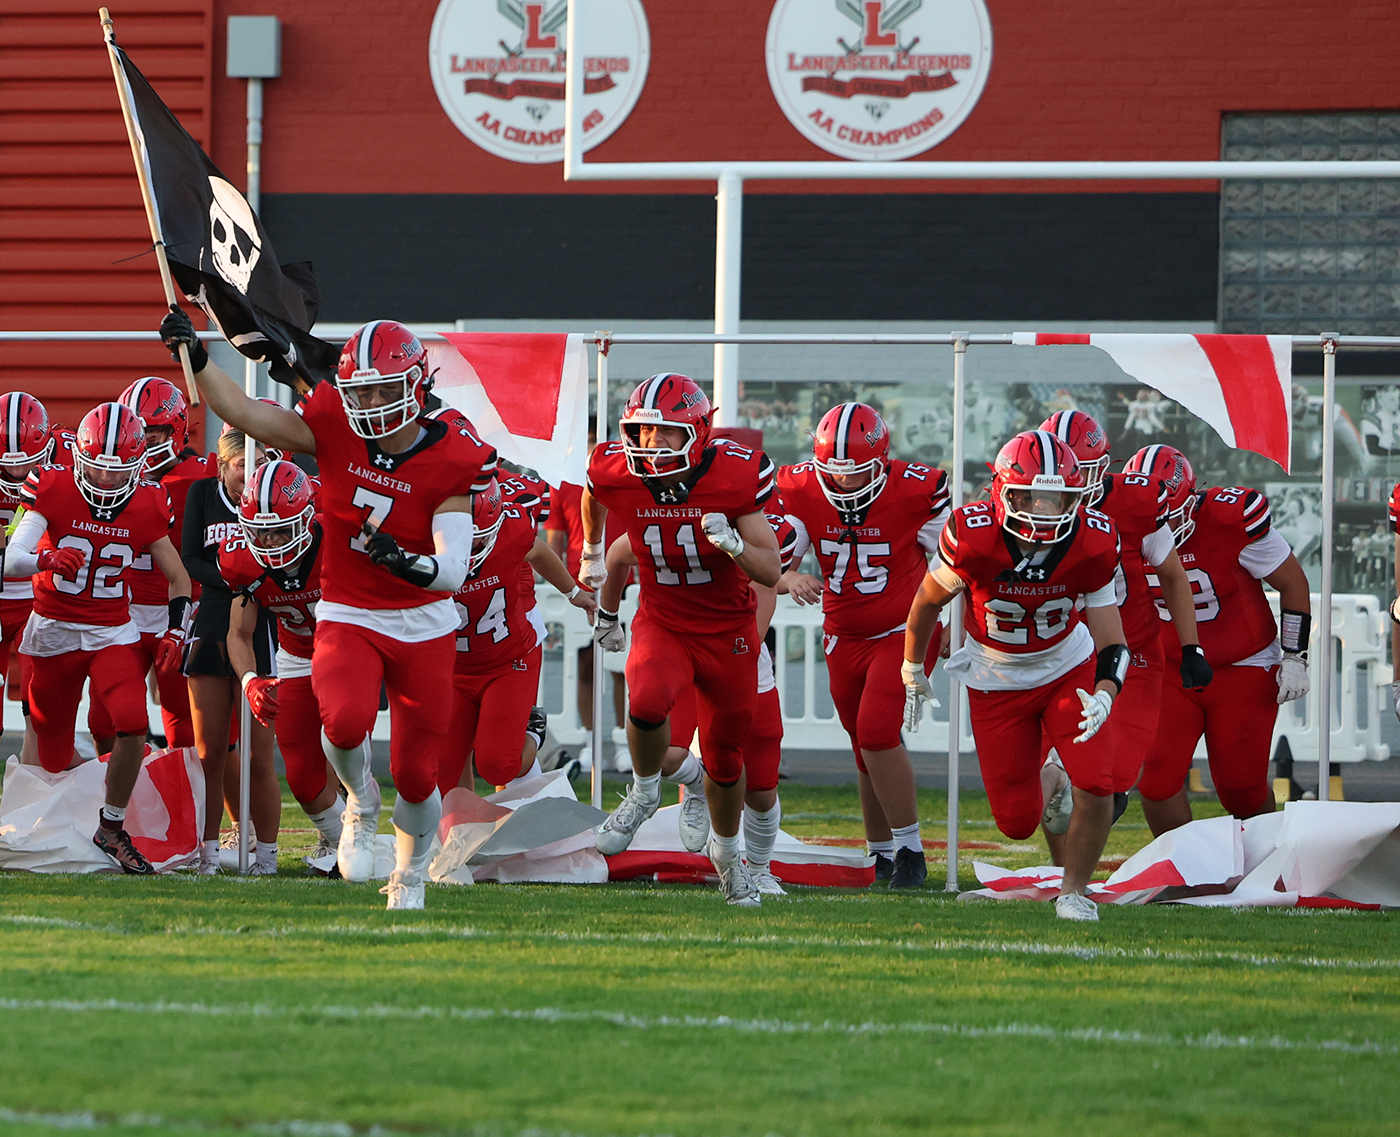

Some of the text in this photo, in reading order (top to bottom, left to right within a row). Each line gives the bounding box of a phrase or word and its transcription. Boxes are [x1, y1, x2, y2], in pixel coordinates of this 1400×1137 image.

[524, 4, 557, 49] L
[863, 1, 897, 46] L
[450, 53, 630, 73] LANCASTER LENDS
[786, 51, 972, 71] LANCASTER LEGENDS
[475, 108, 605, 146] AA CHAMPNS
[808, 106, 945, 146] AA CHAMPIONS
[353, 370, 376, 378] Riddell
[635, 411, 660, 419] Riddell
[459, 428, 484, 447] 7
[725, 446, 754, 461] 11
[347, 462, 412, 493] LANCASTER
[903, 462, 931, 482] 75
[1036, 477, 1063, 485] Riddell
[1165, 454, 1187, 493] Legends
[500, 478, 527, 496] 35
[1214, 487, 1246, 504] 58
[256, 512, 276, 520] Riddell
[349, 485, 395, 555] 7
[636, 508, 703, 518] LANCASTER
[962, 503, 994, 530] 28
[1084, 507, 1112, 534] 28
[71, 519, 130, 538] LANCASTER
[203, 523, 250, 549] LEGE
[826, 525, 881, 537] LANSTER
[643, 523, 714, 586] 11
[52, 534, 135, 600] 32
[819, 538, 892, 596] 75
[267, 588, 325, 603] LANCASTE
[452, 574, 501, 597] NCASTER
[998, 584, 1066, 596] LANCASTER
[454, 586, 512, 653] 24
[983, 596, 1075, 645] 28
